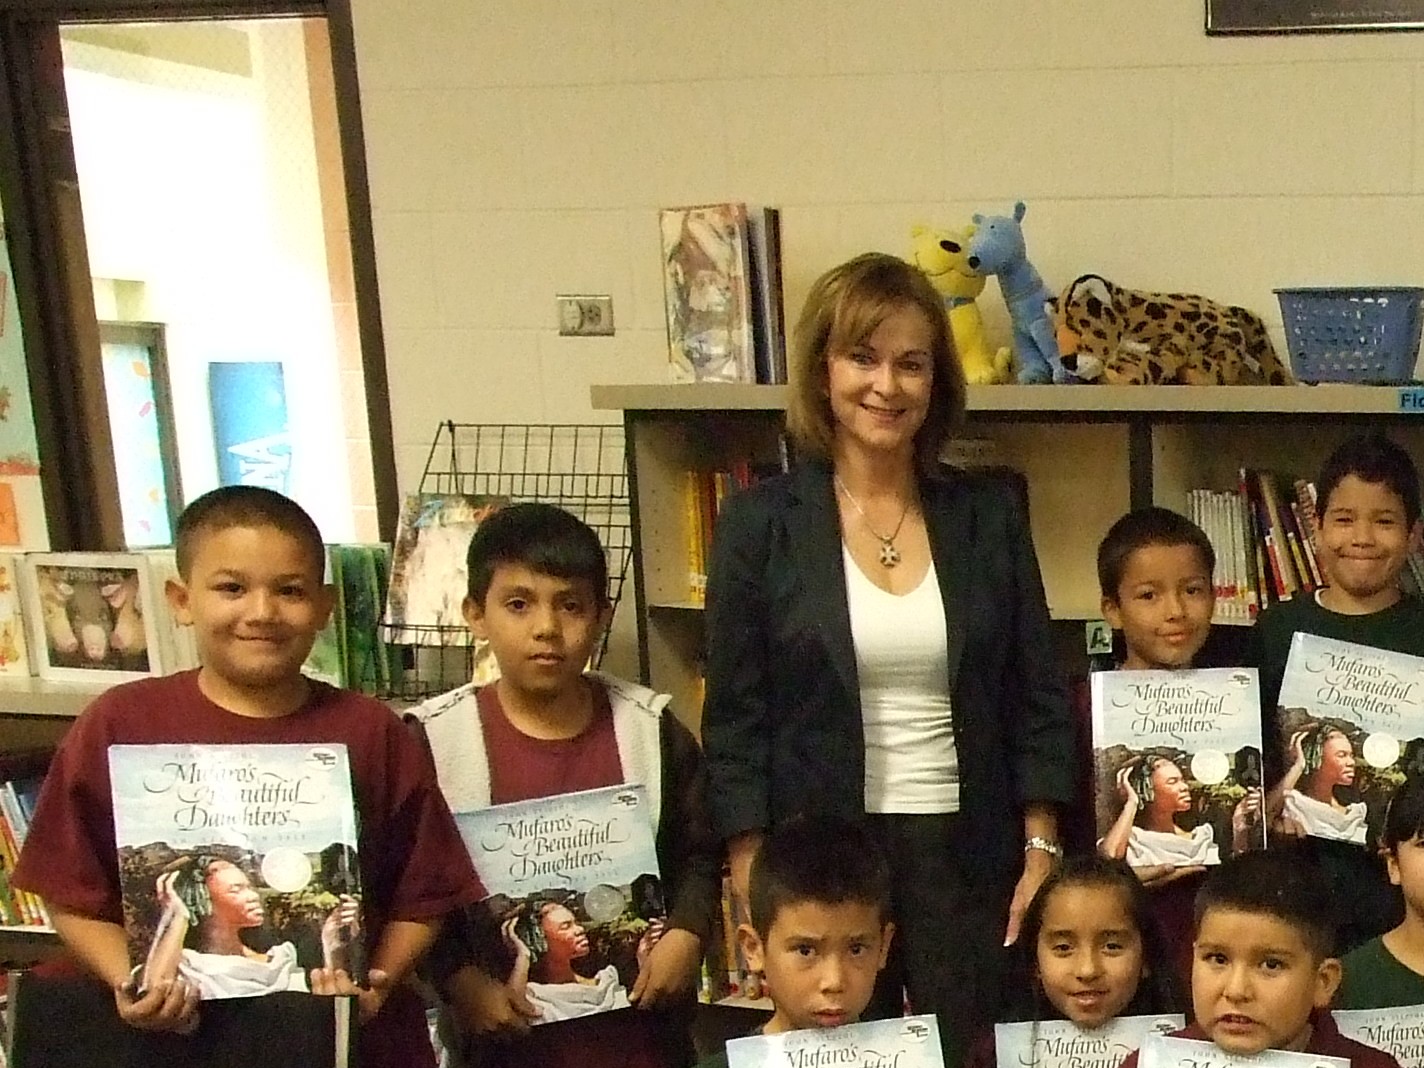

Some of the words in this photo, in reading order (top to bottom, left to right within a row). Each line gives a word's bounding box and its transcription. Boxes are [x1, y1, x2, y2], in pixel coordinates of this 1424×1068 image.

[1305, 652, 1384, 678] Mufaro's
[1112, 682, 1192, 708] Mufaro's
[1135, 690, 1240, 717] Beautiful
[1317, 687, 1401, 721] Daughters
[1325, 673, 1424, 705] Beautiful
[1131, 717, 1221, 744] Daughters
[481, 814, 574, 852] Mufaro's
[511, 818, 631, 857] Beautiful
[509, 851, 613, 883] Daughters
[1019, 1035, 1110, 1066] Mufaro's
